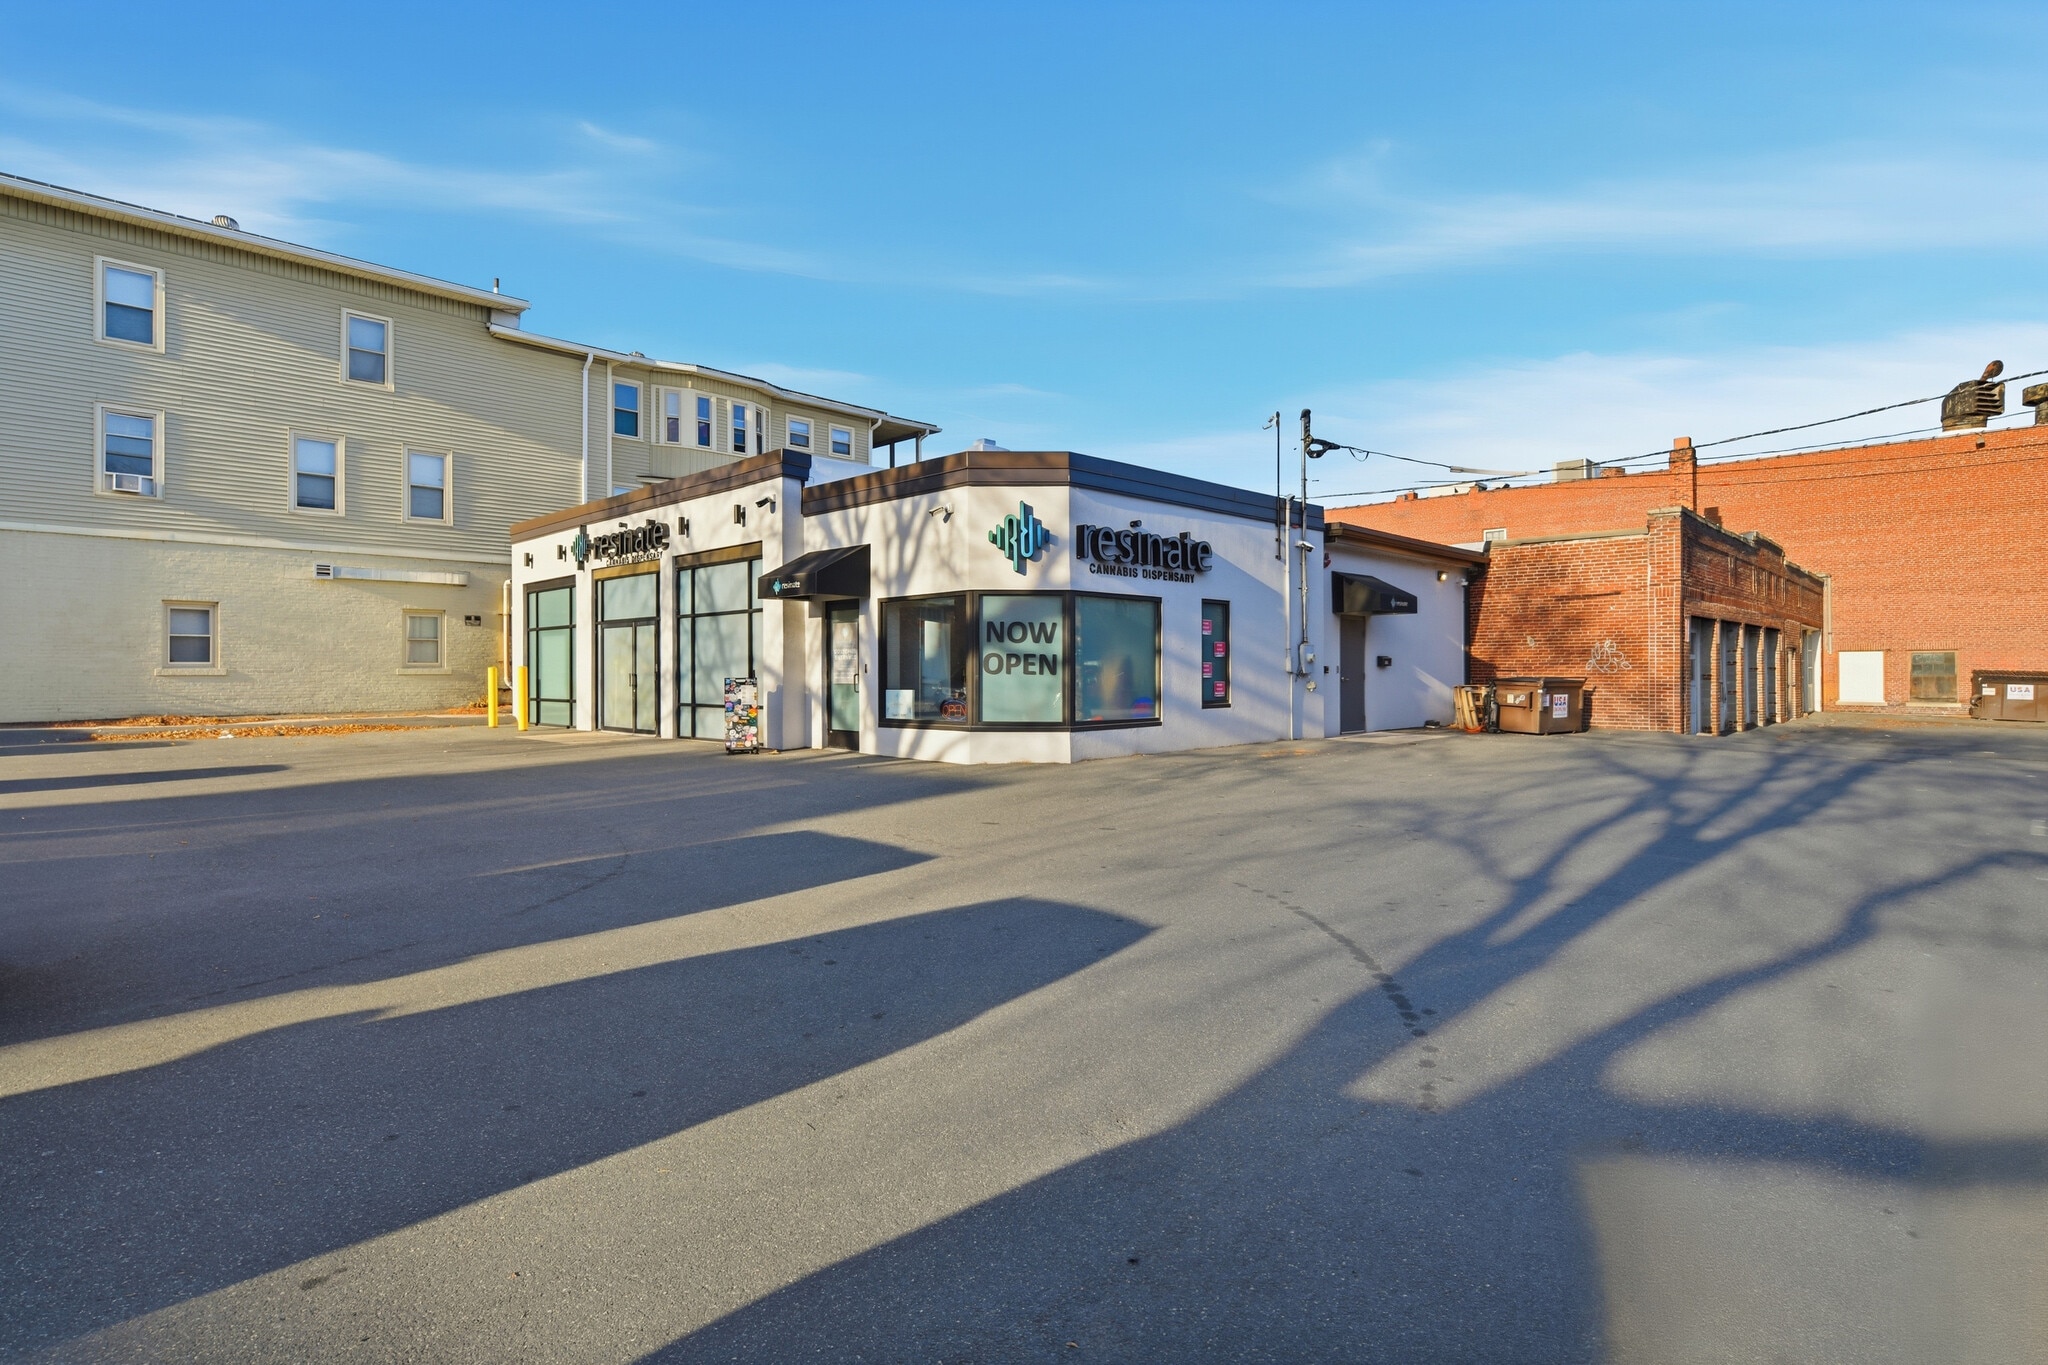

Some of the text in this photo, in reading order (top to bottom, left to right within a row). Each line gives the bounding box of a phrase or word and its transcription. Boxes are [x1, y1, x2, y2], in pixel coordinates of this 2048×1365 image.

[592, 519, 670, 560] resinate
[1076, 520, 1213, 573] resinate
[1089, 563, 1195, 584] CANNABIS DISPENSARY
[986, 621, 1058, 644] NOW
[983, 653, 1058, 676] OPEN
[942, 704, 967, 717] OPEN
[1554, 696, 1566, 706] USA
